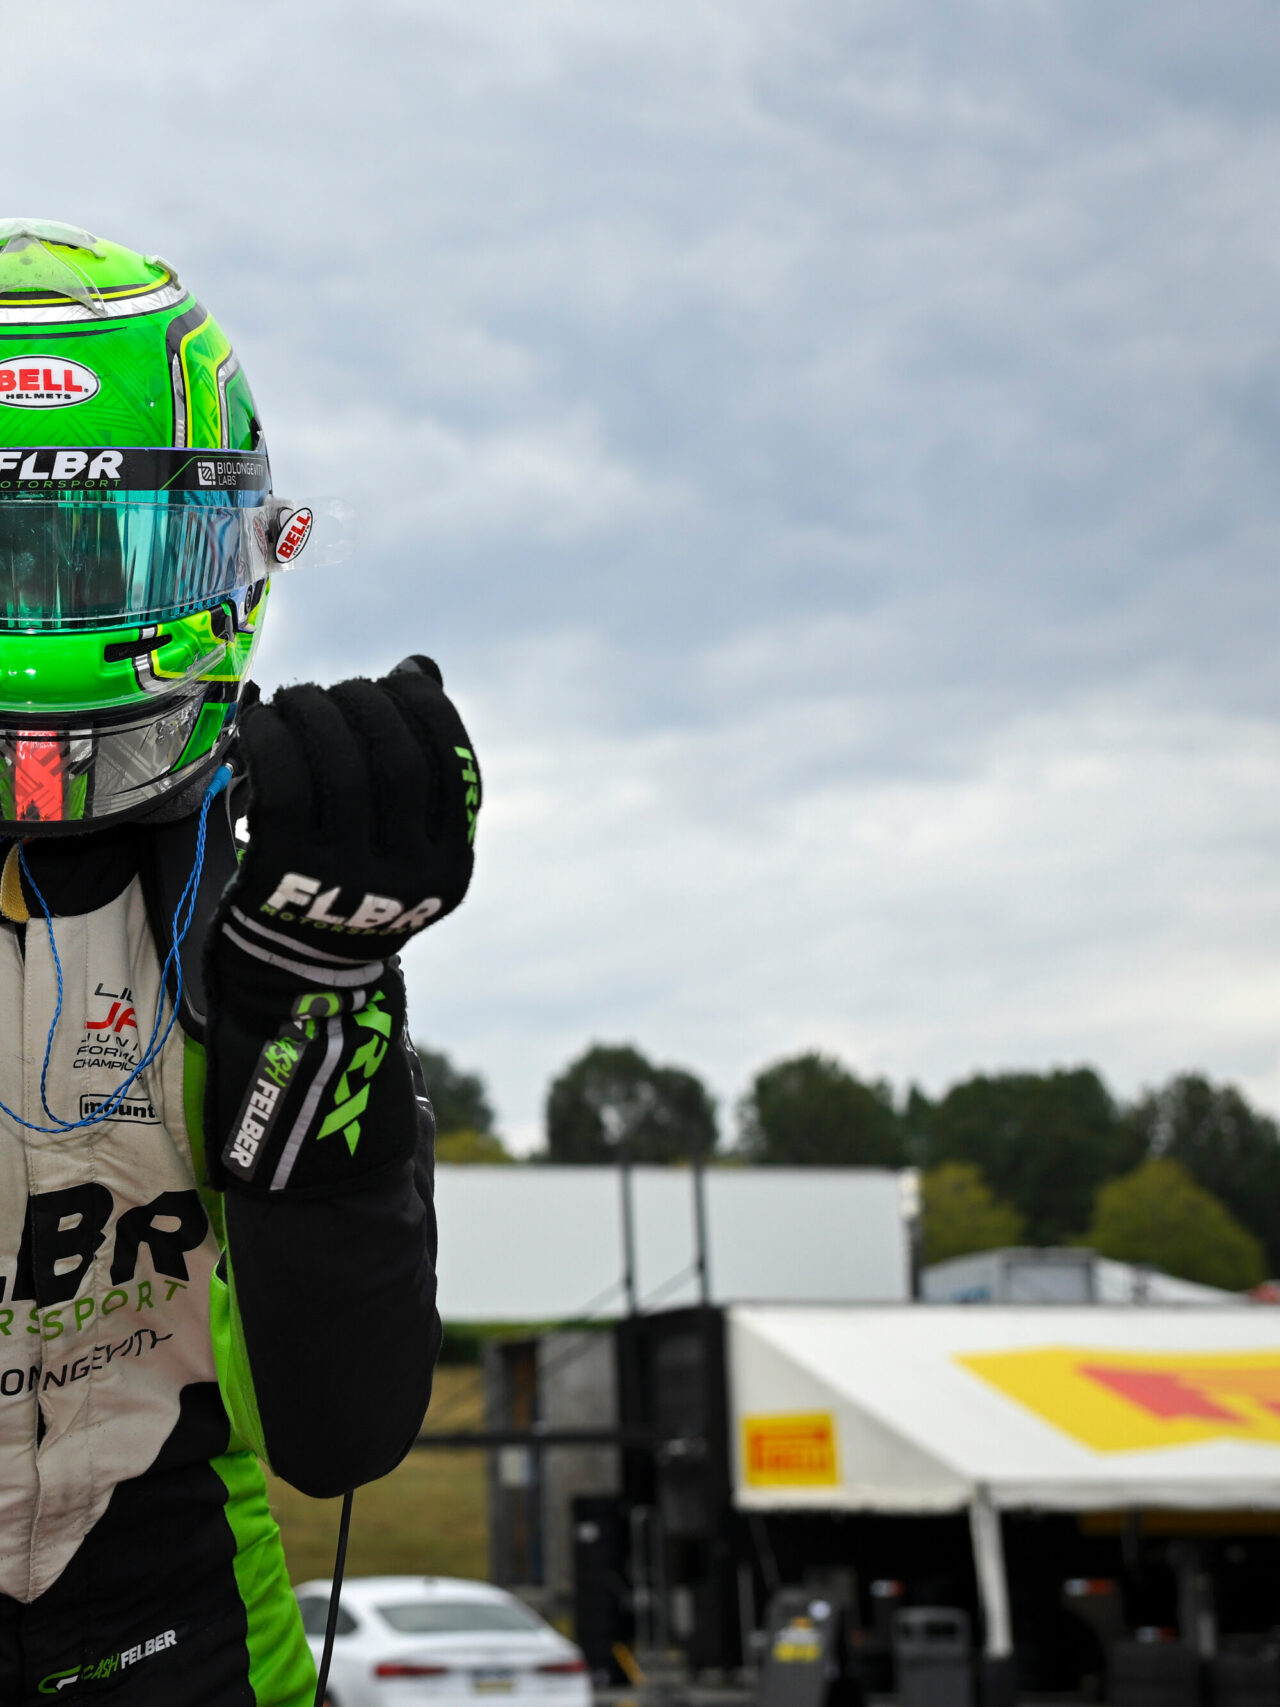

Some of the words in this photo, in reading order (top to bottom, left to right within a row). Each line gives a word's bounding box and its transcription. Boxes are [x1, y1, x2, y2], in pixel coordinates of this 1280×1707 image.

[218, 475, 237, 486] LABS
[277, 515, 312, 560] BELL
[267, 872, 442, 930] FLBR
[229, 1078, 281, 1168] FELBER
[121, 1629, 178, 1670] FELBER
